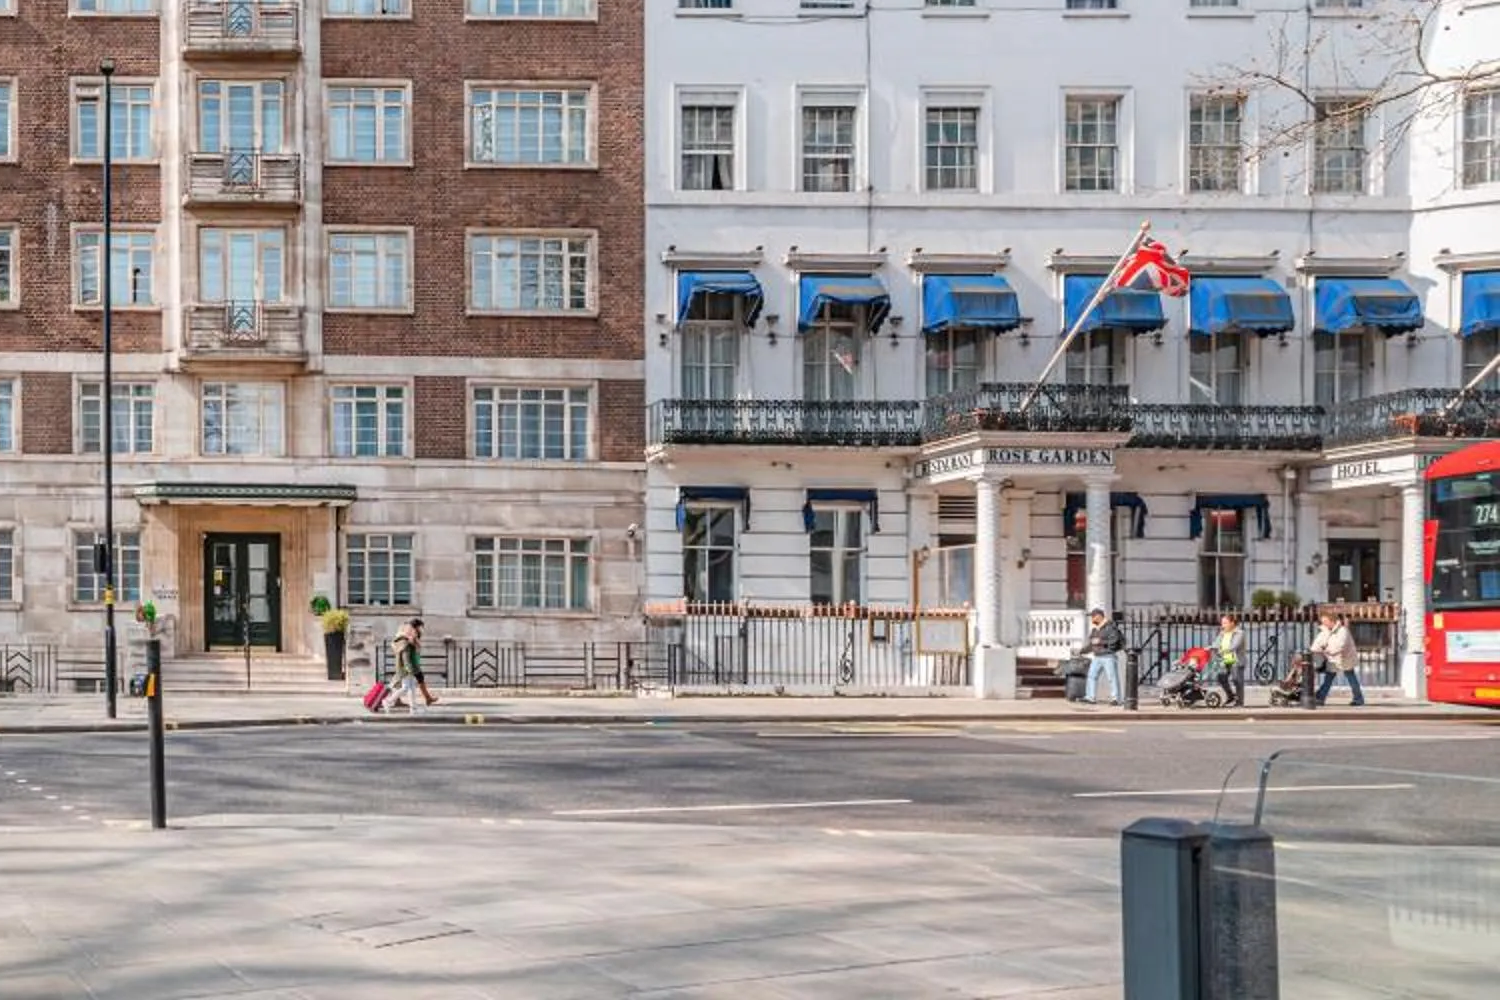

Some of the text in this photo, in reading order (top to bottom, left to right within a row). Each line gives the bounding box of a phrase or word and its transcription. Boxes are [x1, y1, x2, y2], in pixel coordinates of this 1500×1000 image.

[989, 449, 1111, 464] ROSE GARDEN
[1337, 461, 1381, 479] HOTEL
[1476, 504, 1498, 524] 274
